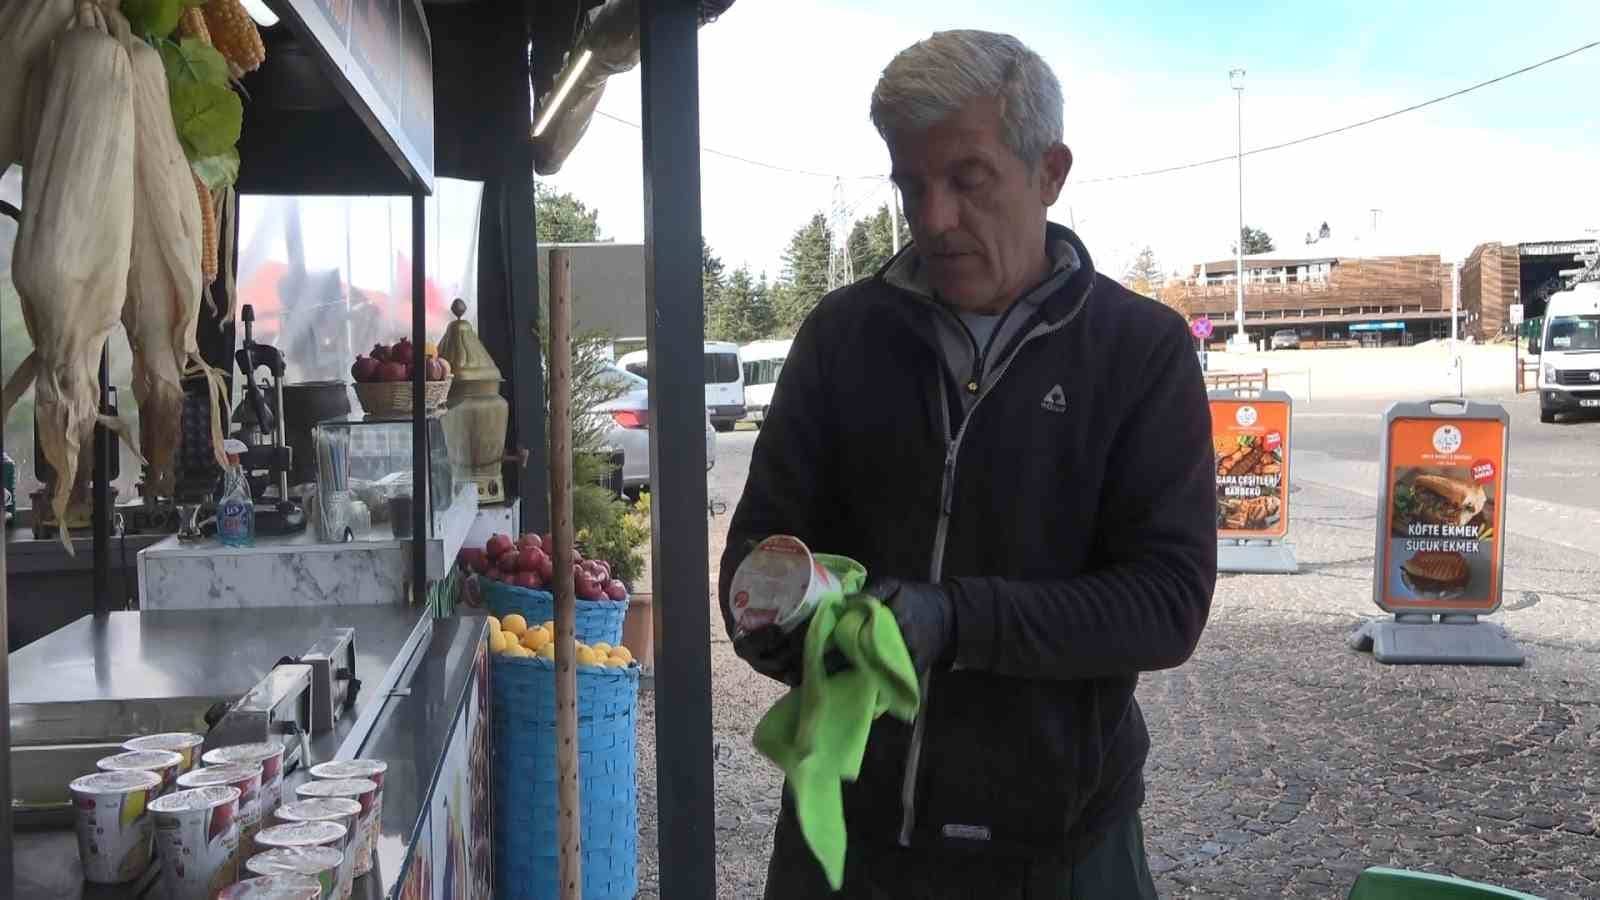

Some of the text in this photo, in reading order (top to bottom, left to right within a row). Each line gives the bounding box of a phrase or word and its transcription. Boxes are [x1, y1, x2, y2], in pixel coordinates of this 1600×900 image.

[1408, 522, 1479, 537] KÖFTE EKMEK
[1406, 539, 1480, 553] SUCUK EKMEK
